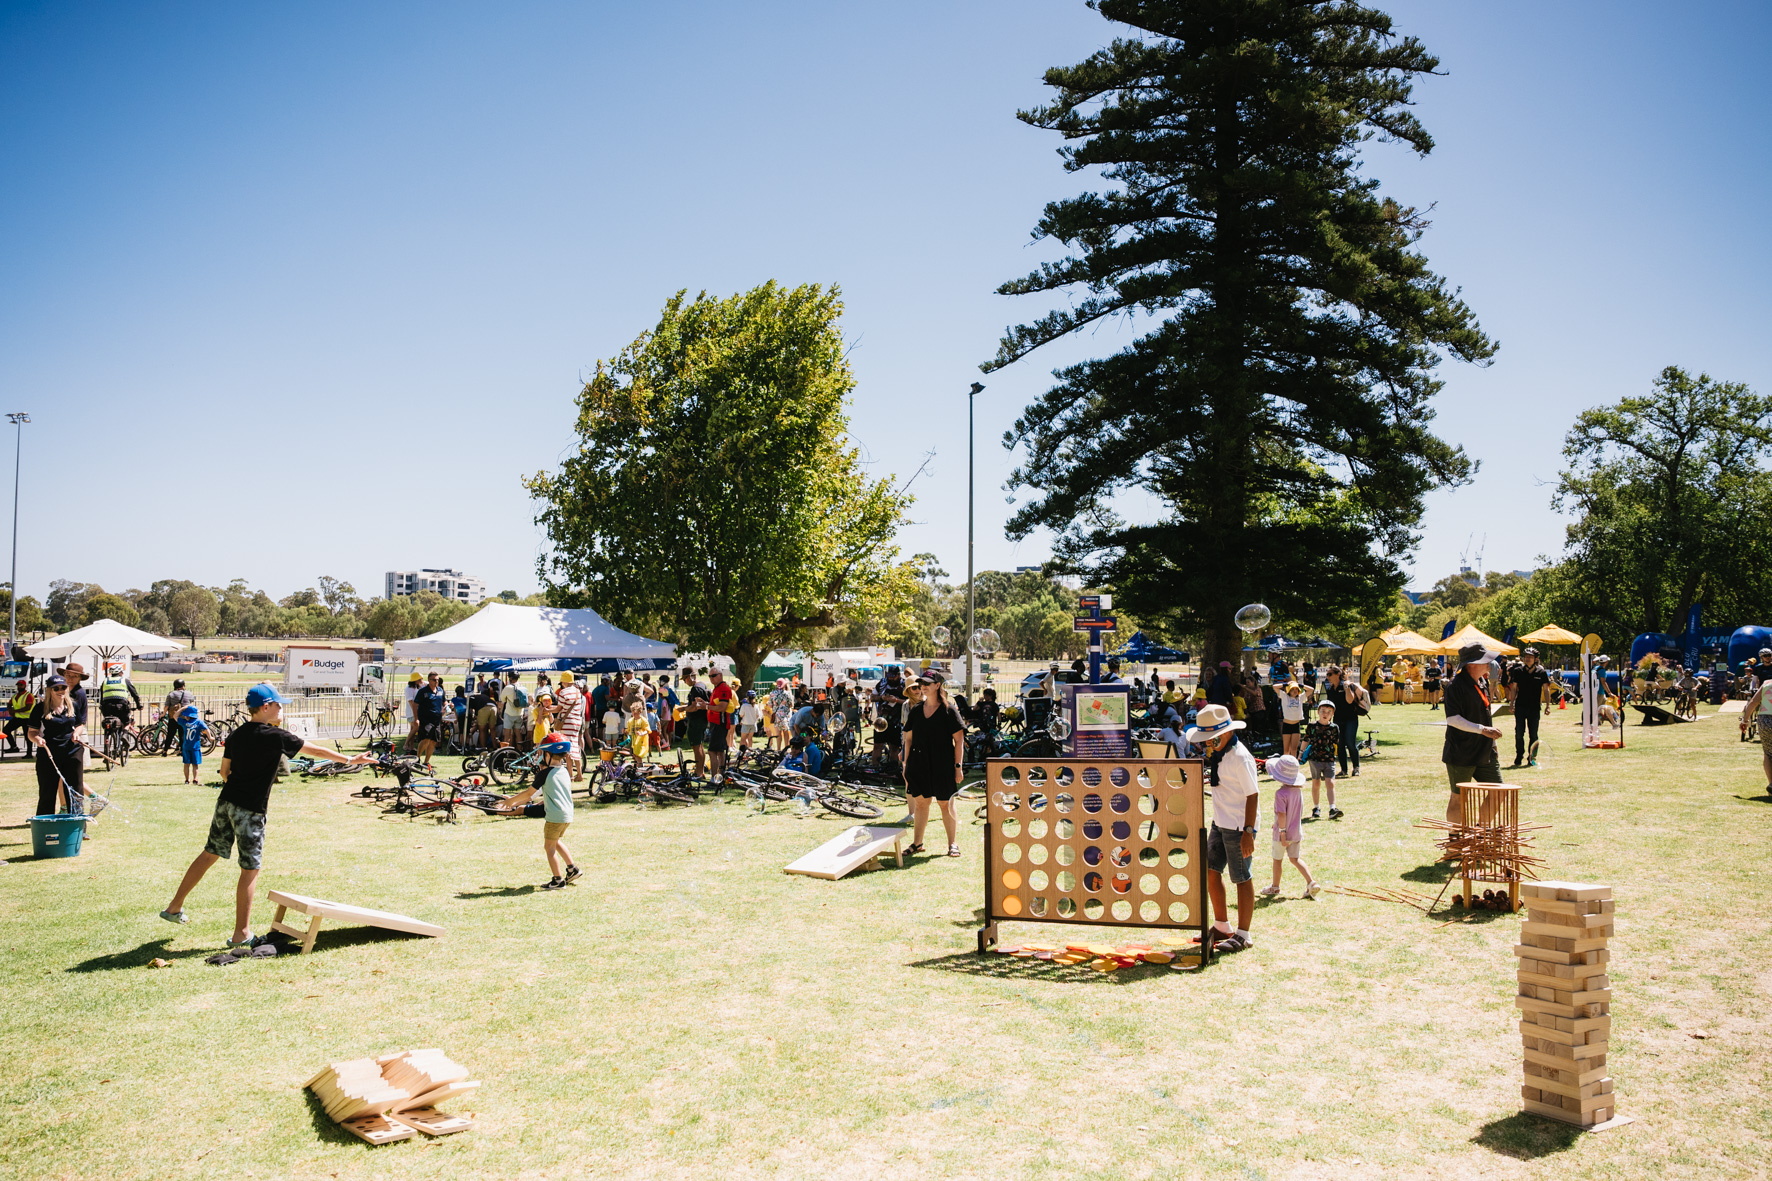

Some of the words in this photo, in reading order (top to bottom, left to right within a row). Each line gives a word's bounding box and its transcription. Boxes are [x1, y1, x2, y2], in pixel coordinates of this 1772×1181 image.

[1702, 636, 1730, 644] YAM
[314, 660, 344, 670] Budget
[817, 662, 833, 672] Budget
[186, 728, 196, 741] 10
